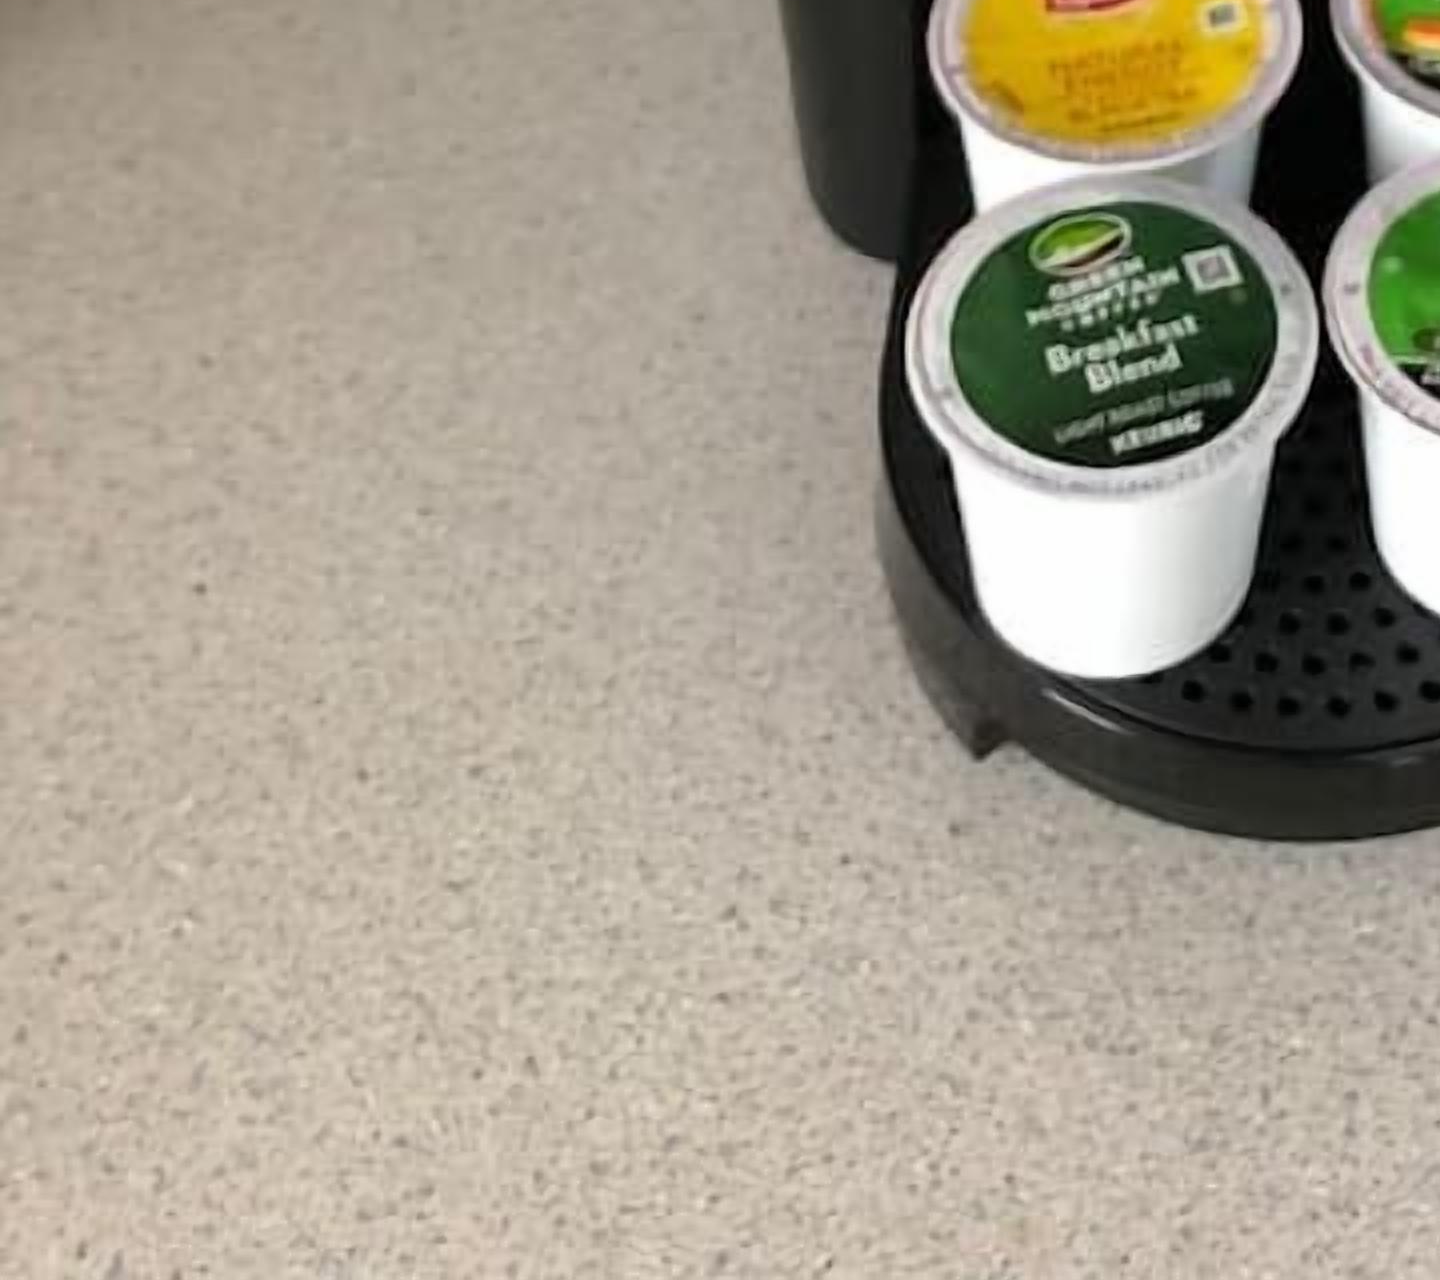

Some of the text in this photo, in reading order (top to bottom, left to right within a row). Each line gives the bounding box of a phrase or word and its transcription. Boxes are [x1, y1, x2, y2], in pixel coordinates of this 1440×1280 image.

[1024, 266, 1180, 328] MOUNTAIN
[1047, 255, 1146, 302] GREEN
[1045, 314, 1200, 377] Breakfast
[1085, 341, 1183, 395] Blend
[1108, 409, 1205, 455] KEURIG
